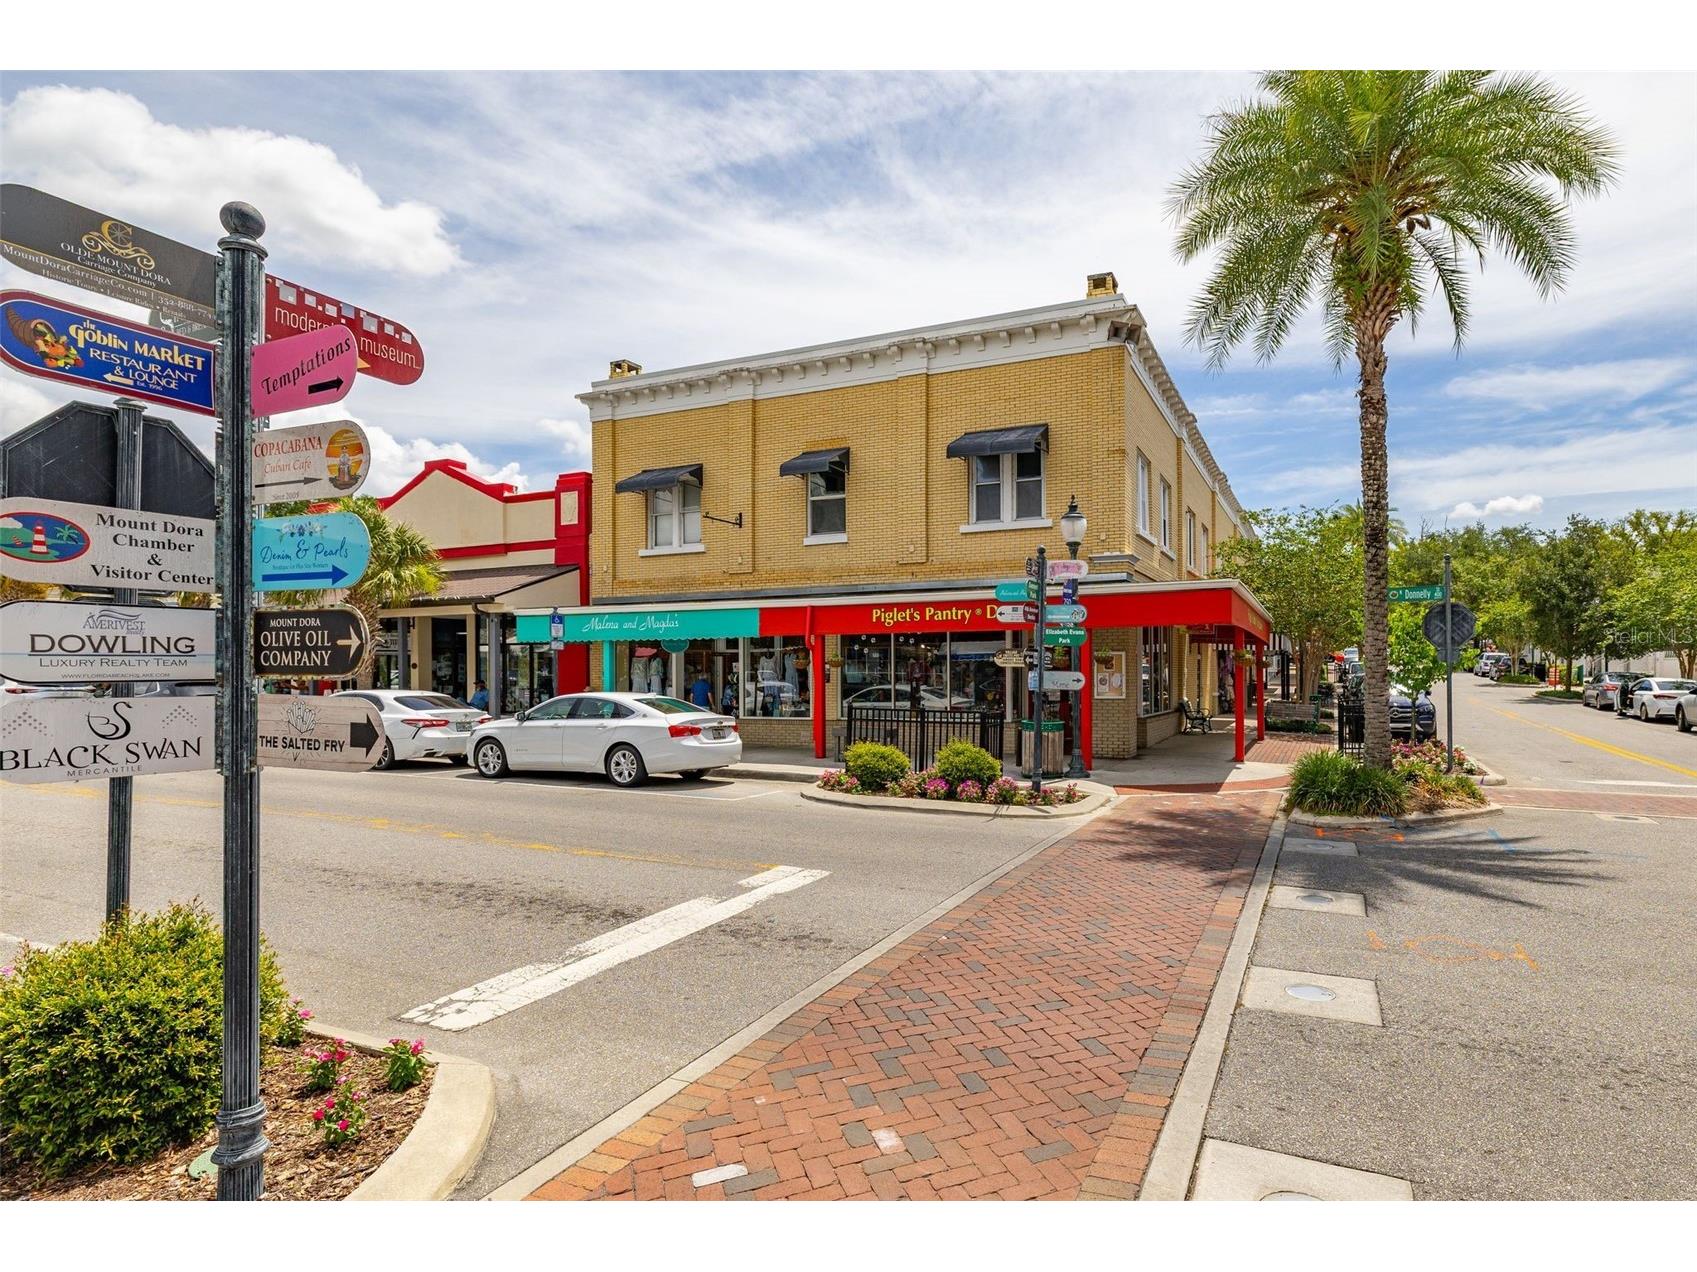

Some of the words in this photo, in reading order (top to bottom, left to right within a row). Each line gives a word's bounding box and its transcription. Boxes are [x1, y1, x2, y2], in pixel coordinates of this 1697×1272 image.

[61, 242, 94, 260] OLDE
[99, 255, 138, 274] MOUNT
[140, 267, 171, 286] DORA
[117, 268, 156, 289] Company
[90, 348, 198, 383] RESTAURANT
[261, 337, 351, 395] Temptations
[114, 365, 124, 376] &
[129, 369, 178, 390] LOUNGE
[254, 436, 323, 458] COPACABANA
[264, 460, 292, 474] Cuban
[96, 512, 156, 532] Mount
[163, 520, 204, 537] Dora
[113, 533, 195, 553] Chamber
[260, 545, 292, 563] Denim
[296, 539, 310, 559] &
[314, 536, 348, 560] Pearls
[147, 553, 162, 566] &
[90, 564, 152, 581] Visitor
[158, 570, 214, 585] Center
[1405, 589, 1431, 599] Donnelly
[270, 618, 298, 627] MOUNT
[300, 618, 320, 627] DORA
[623, 616, 638, 629] and
[872, 607, 920, 627] Piglet's
[925, 606, 972, 625] Pantry
[30, 634, 196, 654] DOWLING
[260, 631, 300, 647] OLIVE
[305, 630, 331, 646] OIL
[260, 650, 331, 666] COMPANY
[0, 745, 118, 771] BLACK
[126, 736, 203, 765] SWAN
[259, 735, 278, 748] THE
[282, 736, 320, 750] SALTED
[324, 739, 345, 752] FRY
[67, 765, 143, 777] MERCANTILE
